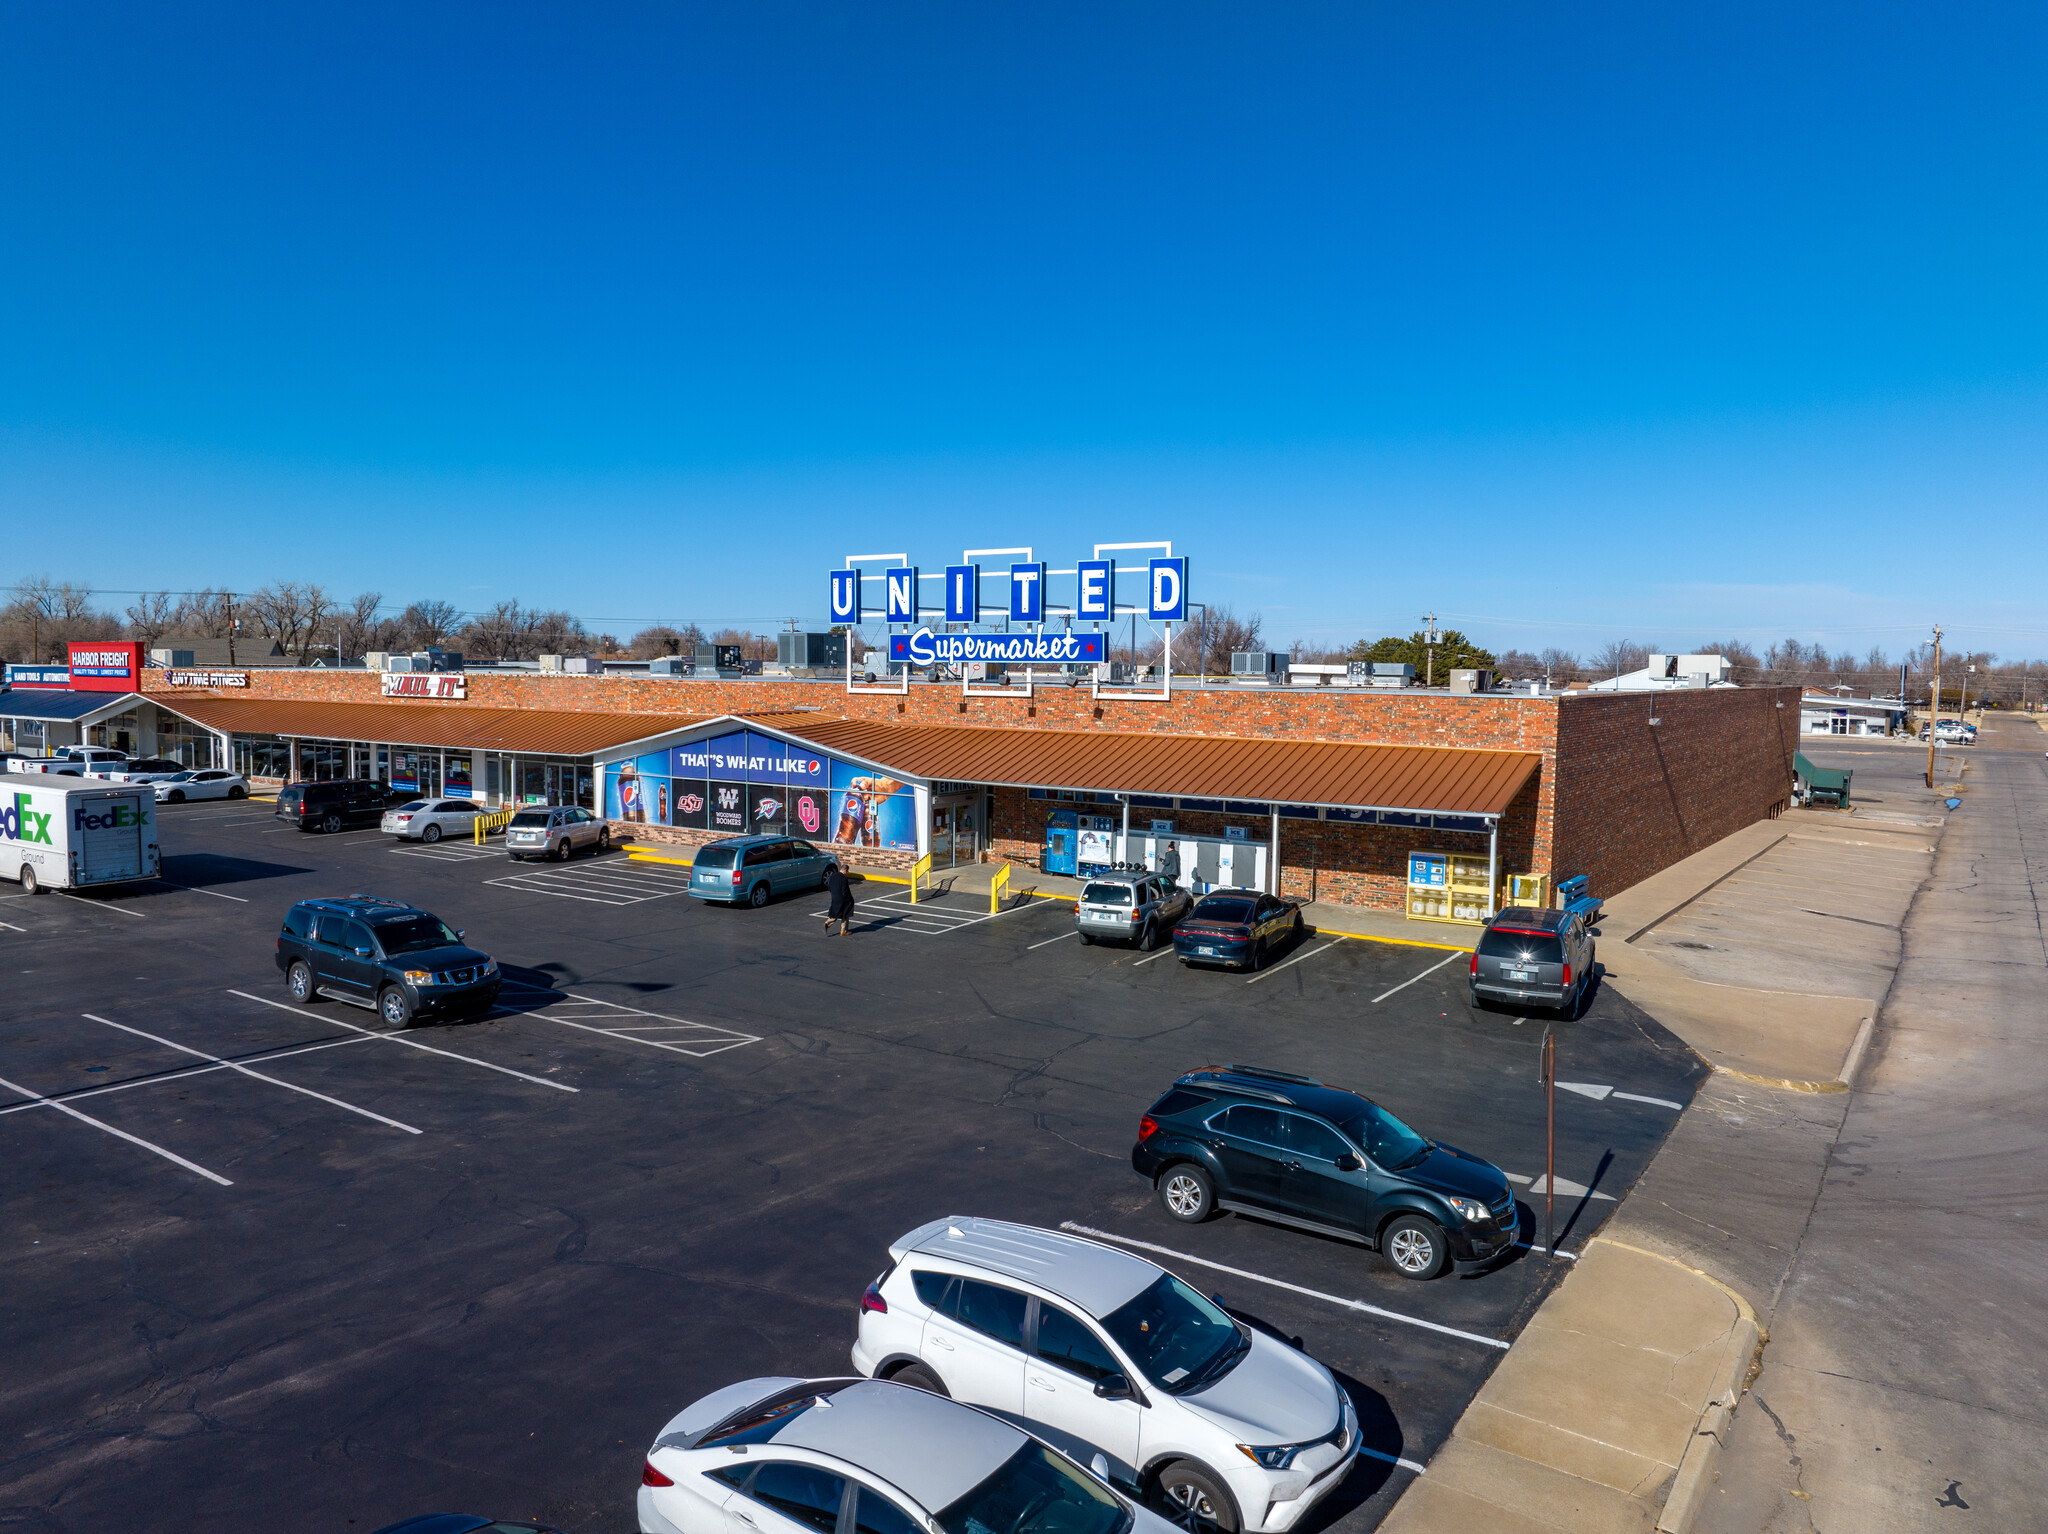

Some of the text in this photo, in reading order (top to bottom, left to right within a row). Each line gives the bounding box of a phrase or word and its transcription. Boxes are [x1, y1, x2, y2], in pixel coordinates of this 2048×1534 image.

[832, 567, 1181, 616] UNITED
[909, 623, 1081, 666] Supermarket
[72, 652, 129, 667] HARBOR FREIGHT
[14, 672, 40, 681] HAND TOOLS
[43, 672, 70, 682] AUTOMOTIVE
[171, 672, 246, 687] ANYTIME FITNESS
[384, 675, 460, 697] MAIL IT
[679, 753, 807, 773] THAT'S WHAT I LIKE
[678, 794, 704, 813] OSU
[74, 804, 151, 832] FedEx
[716, 817, 742, 826] BOOMERS
[20, 848, 45, 865] Ground
